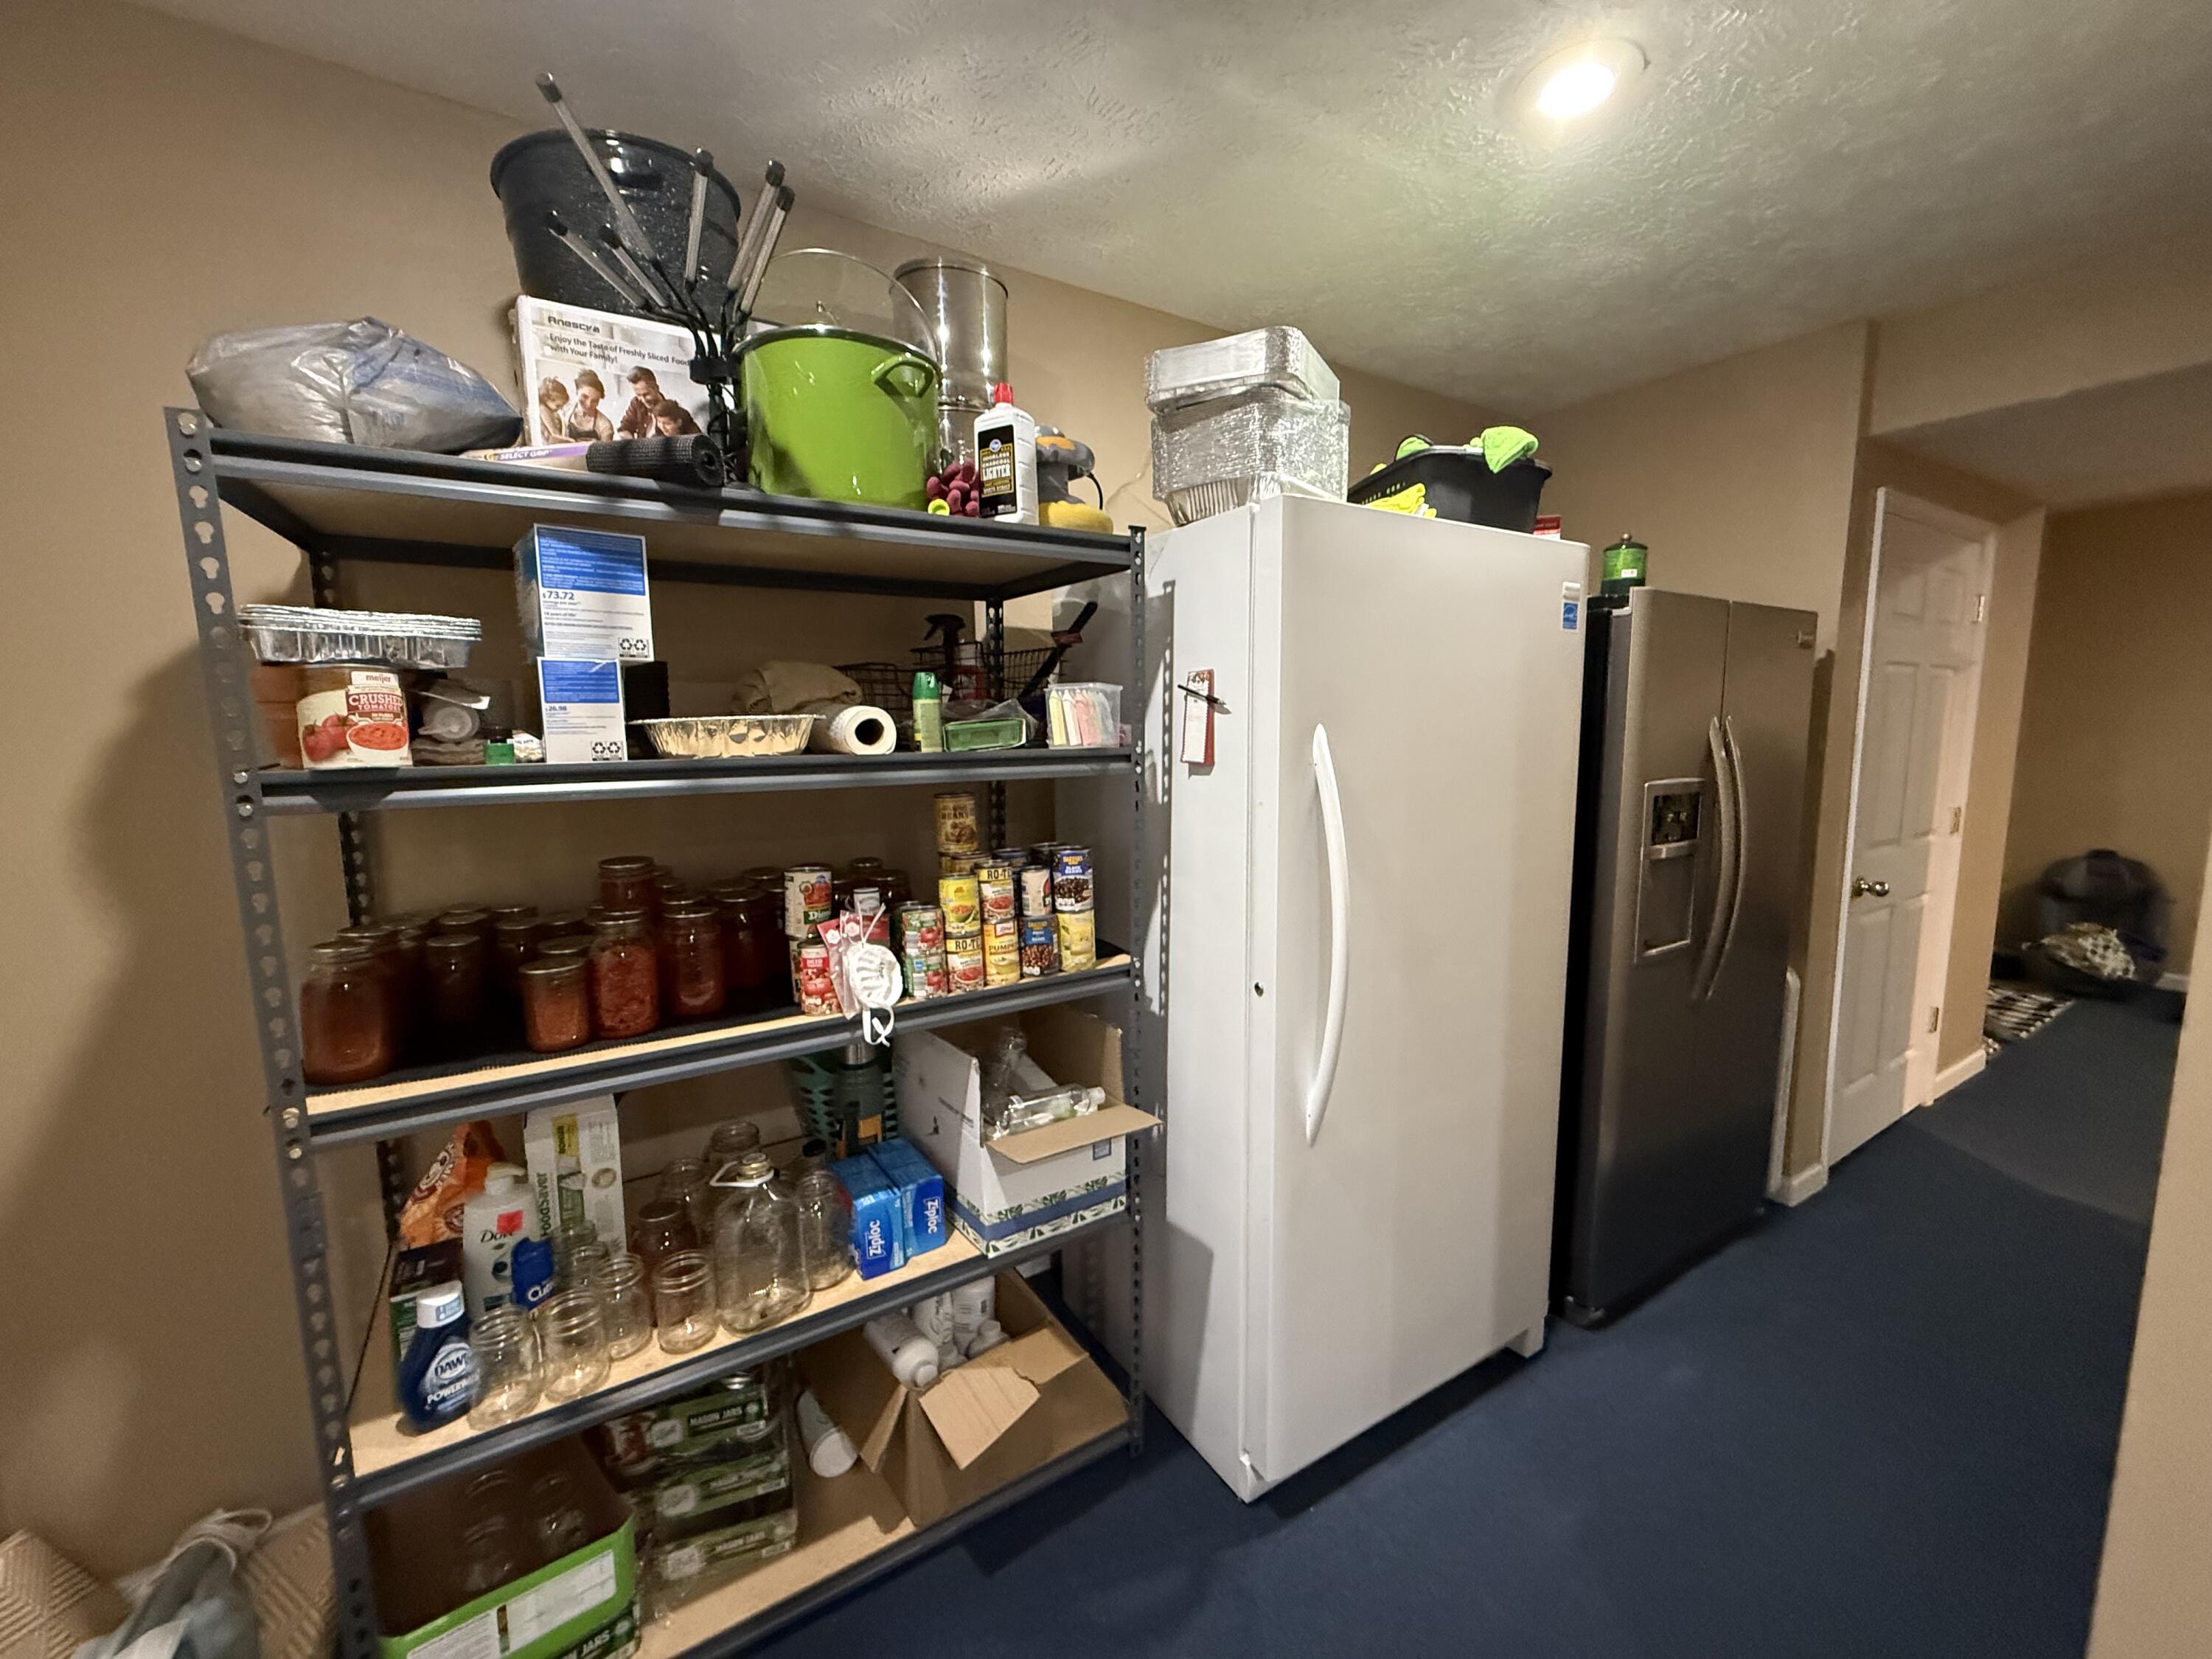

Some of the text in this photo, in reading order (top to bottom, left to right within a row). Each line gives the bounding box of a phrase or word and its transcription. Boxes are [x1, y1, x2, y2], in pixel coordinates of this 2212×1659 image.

[549, 333, 573, 346] Enjoy
[574, 338, 587, 347] the
[588, 341, 609, 352] Taste
[619, 347, 646, 361] Freshly
[647, 352, 669, 363] Sliced
[551, 344, 568, 354] with
[570, 348, 588, 358] Your
[500, 451, 528, 460] SELECT
[982, 464, 1011, 481] LIGHTER
[542, 591, 575, 600] $73.72
[366, 674, 392, 683] meijer
[349, 692, 404, 708] CRUSHED
[924, 1199, 939, 1234] Ziploc
[869, 1220, 885, 1256] Ziploc
[722, 1406, 742, 1419] JARS
[581, 1630, 611, 1657] JARS
